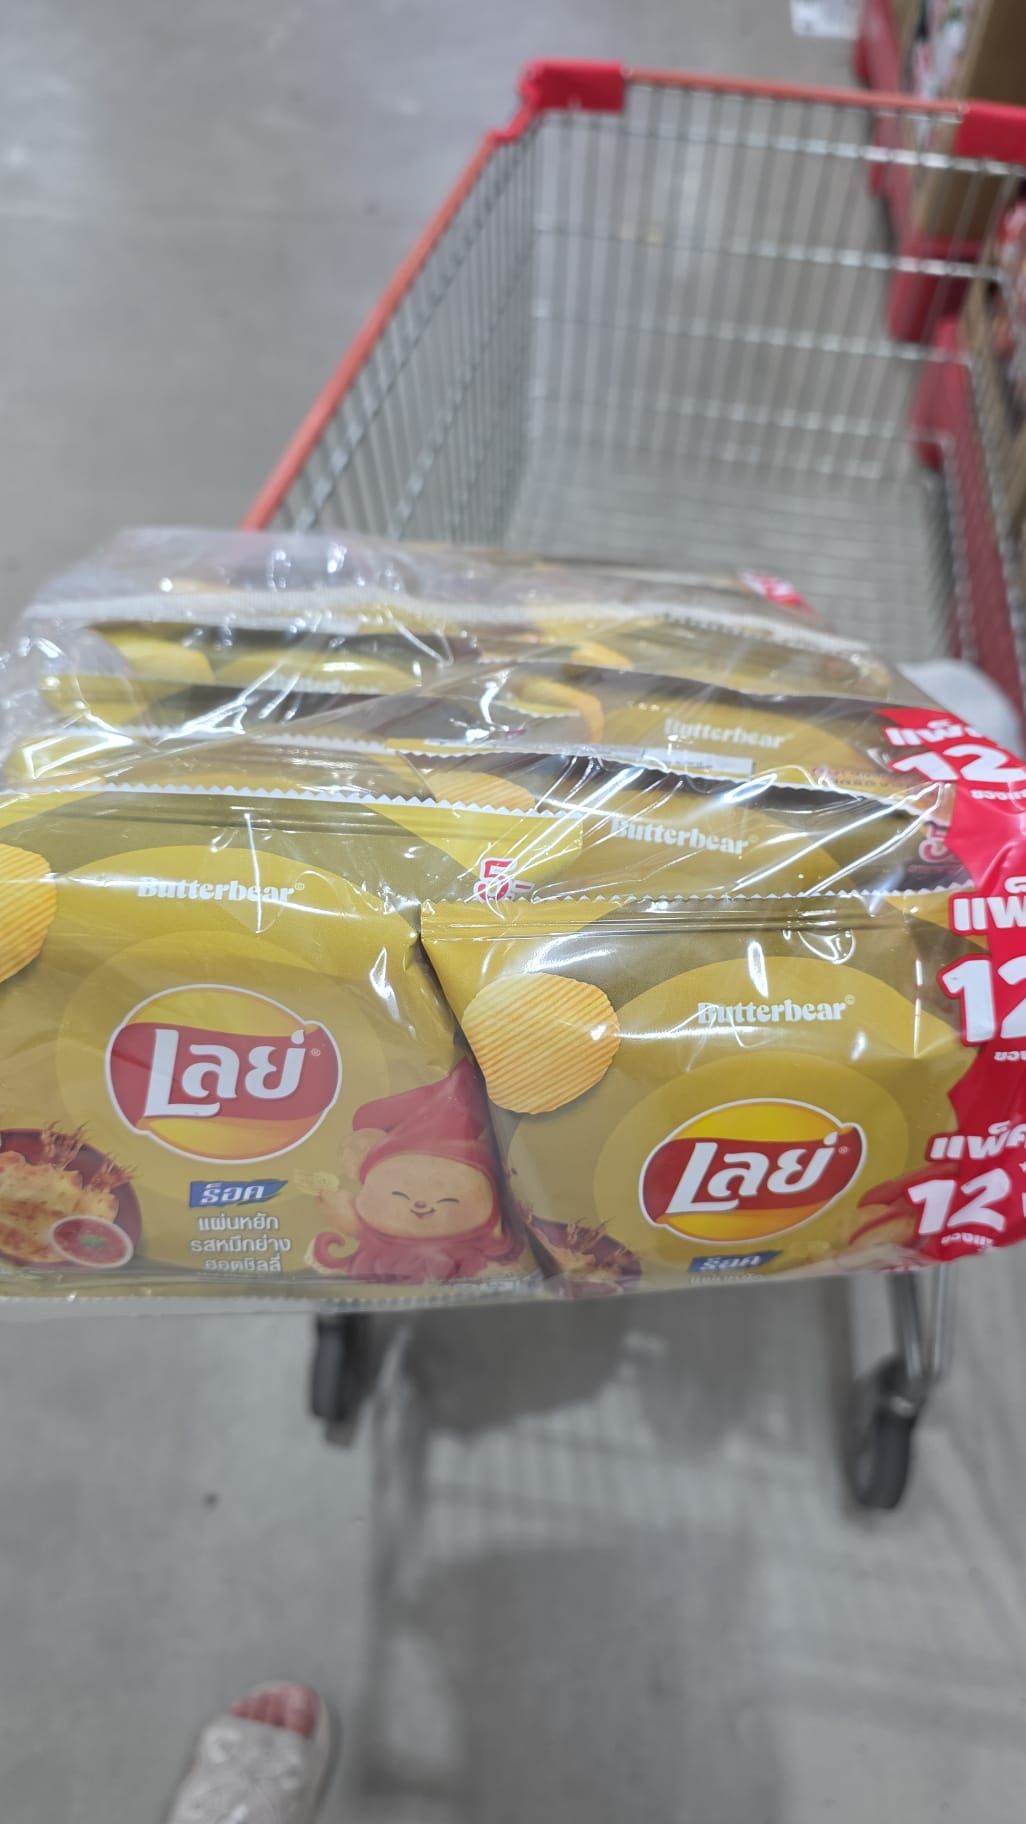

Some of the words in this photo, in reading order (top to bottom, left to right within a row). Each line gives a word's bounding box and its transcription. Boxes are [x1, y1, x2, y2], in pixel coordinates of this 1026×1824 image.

[892, 744, 1026, 783] 12
[610, 817, 749, 855] Butterbear
[137, 878, 295, 902] Butterbear
[697, 999, 846, 1024] Butterbear
[201, 1183, 264, 1204] ร็อค
[908, 1168, 1011, 1235] 12
